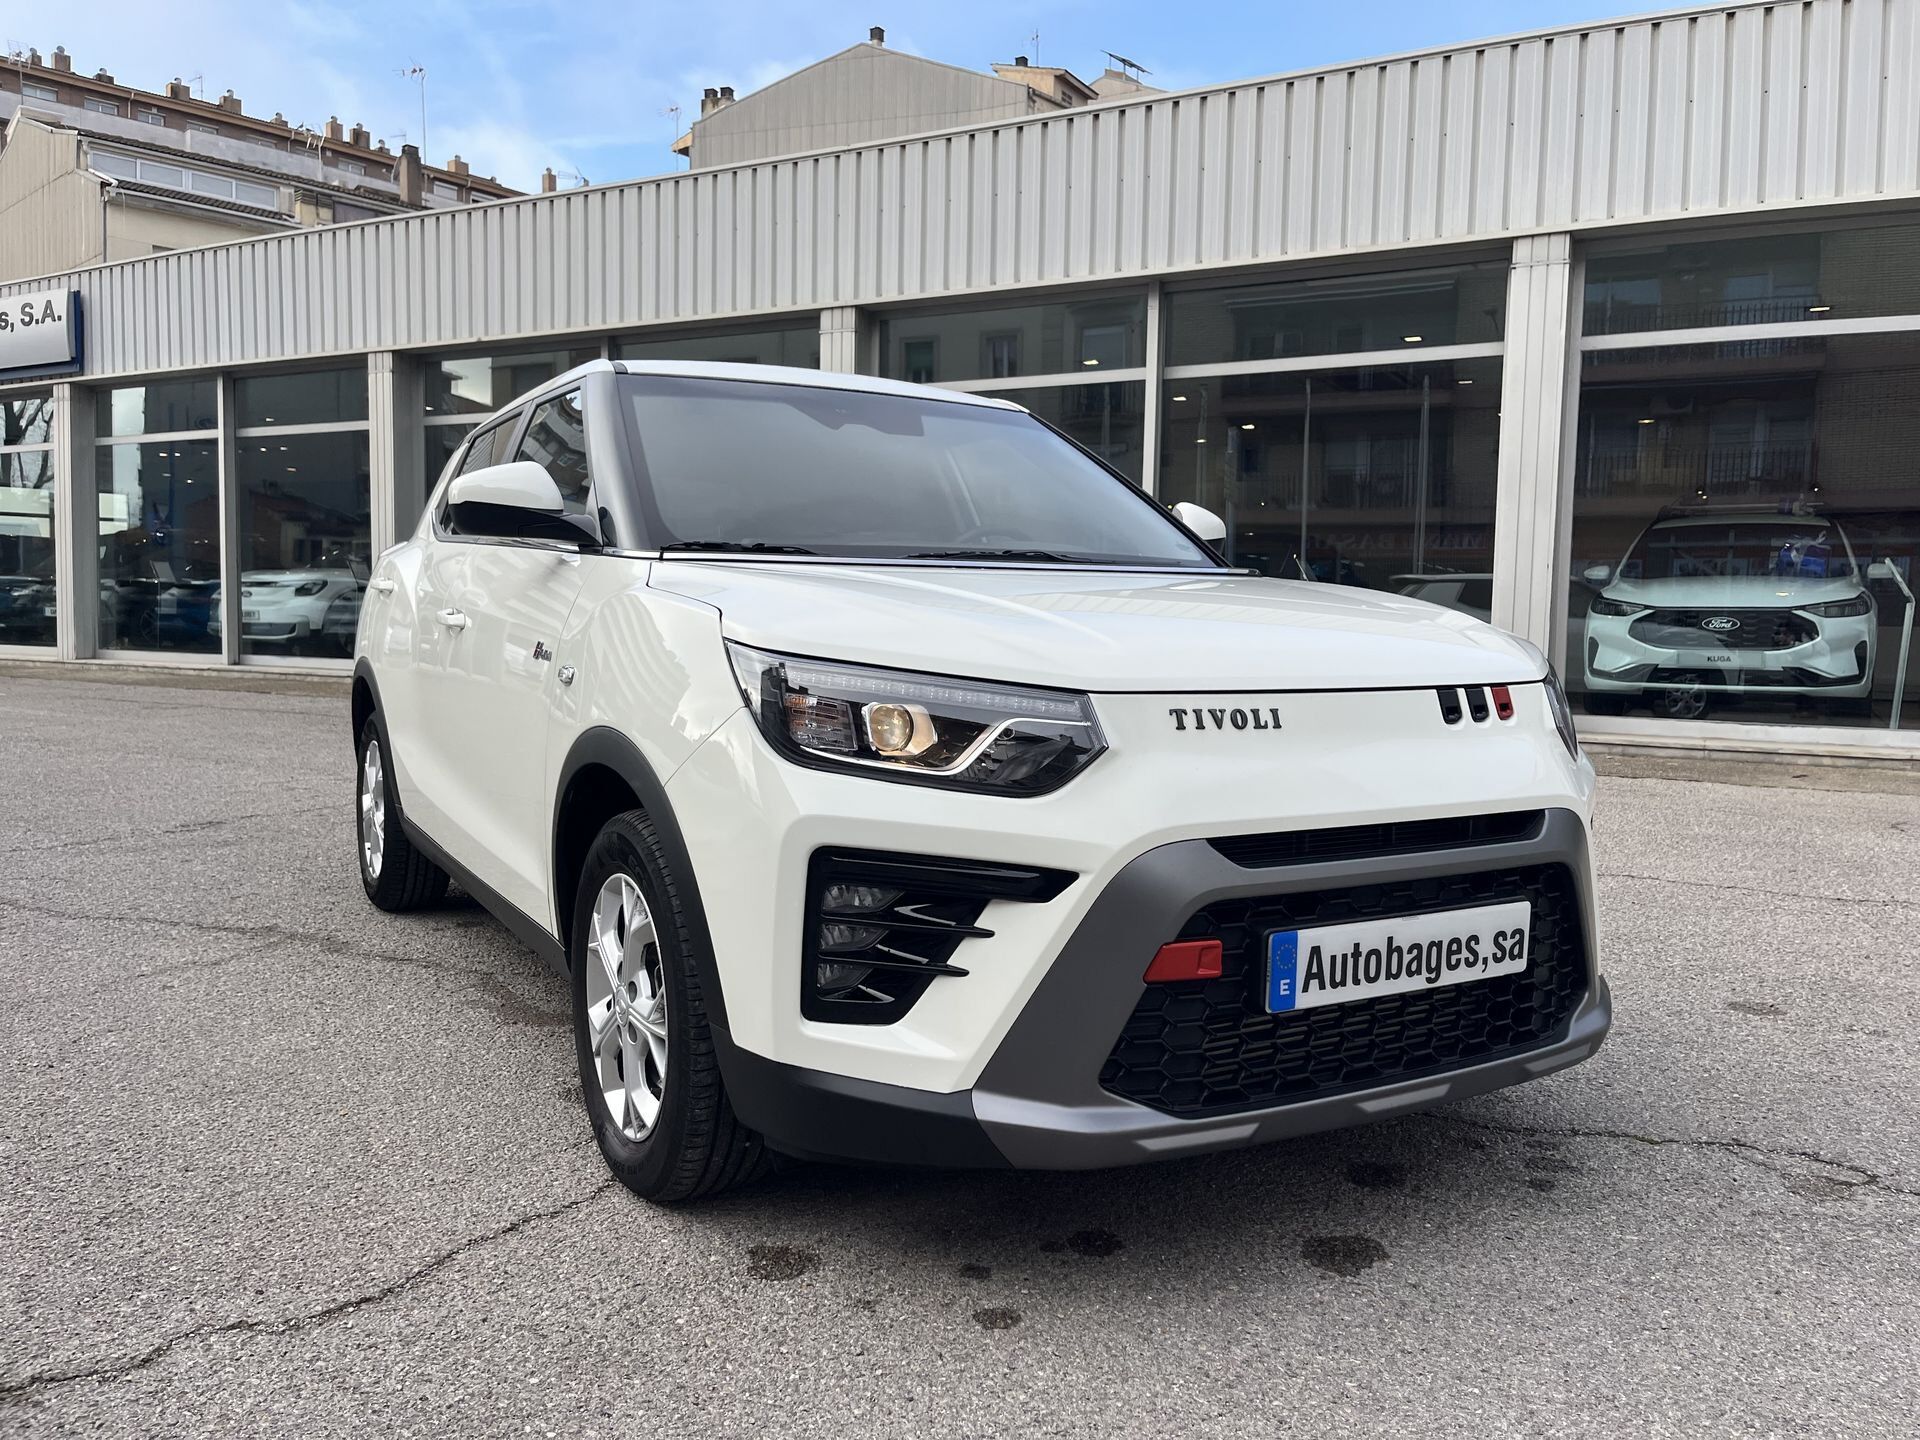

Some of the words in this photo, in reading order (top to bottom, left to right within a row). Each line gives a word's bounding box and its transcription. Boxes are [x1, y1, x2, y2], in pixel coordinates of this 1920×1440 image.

[20, 299, 62, 327] S.A.
[1708, 618, 1733, 629] Ford
[1169, 708, 1282, 730] TIVOLI
[1279, 979, 1291, 996] E
[1301, 927, 1525, 993] Autobages,sa
